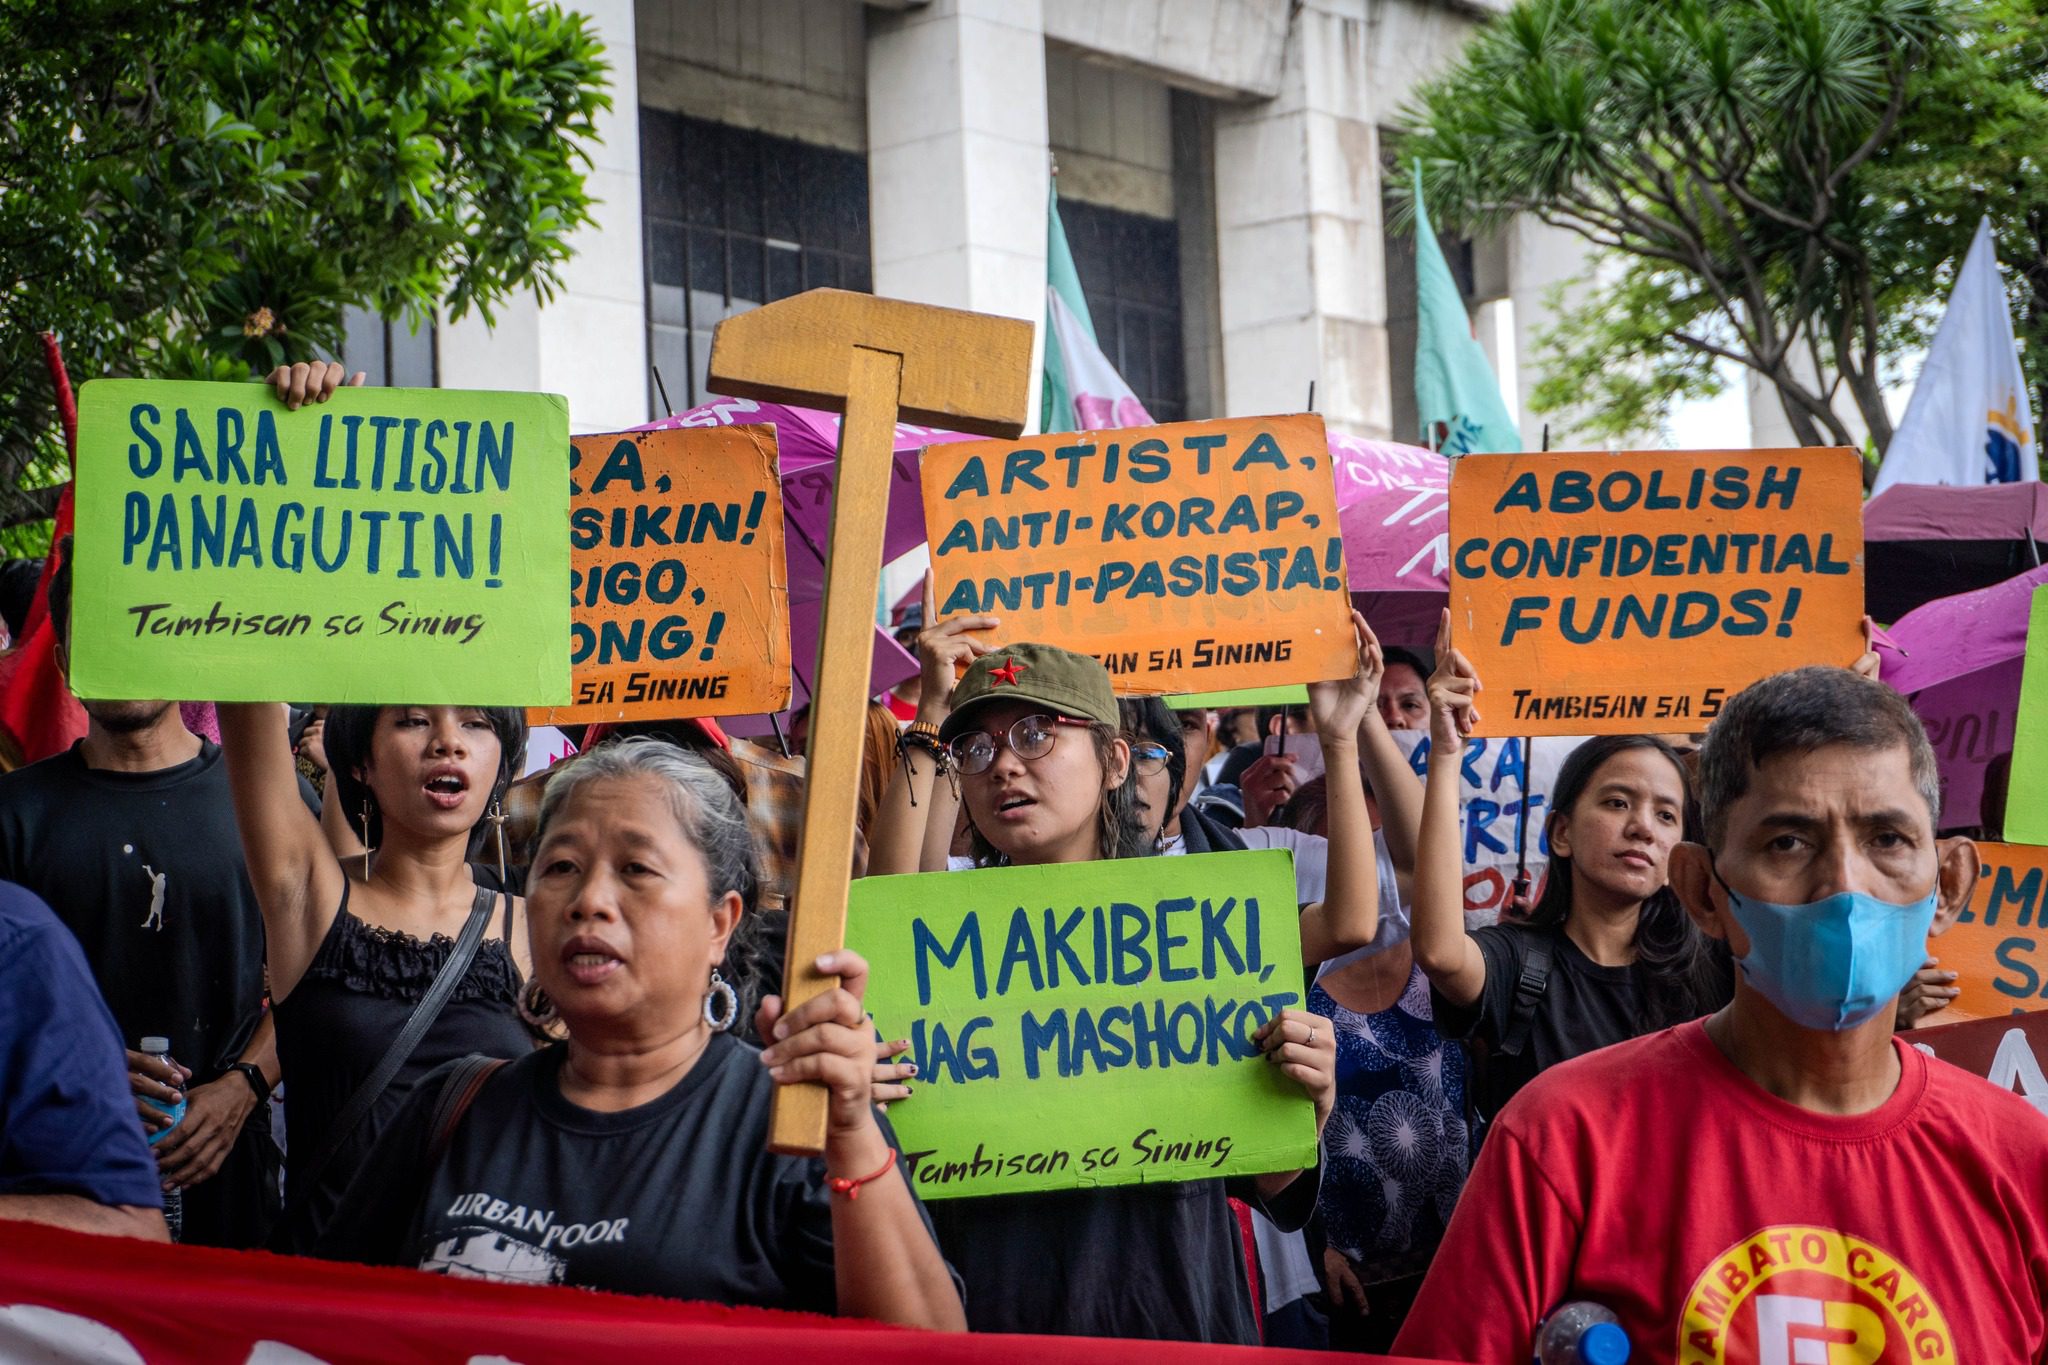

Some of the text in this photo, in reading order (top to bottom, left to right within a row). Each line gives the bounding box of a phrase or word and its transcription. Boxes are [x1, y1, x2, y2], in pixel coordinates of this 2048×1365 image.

[128, 403, 515, 494] SARA LITISIN
[944, 433, 1317, 499] ARTISTA,
[1493, 465, 1802, 514] ABOLISH
[123, 491, 503, 588] PANAGUTIN!
[937, 491, 1321, 556] ANTI-KORAP,
[940, 537, 1343, 616] ANTI-PASISTA!
[1454, 533, 1851, 580] CONFIDENTIAL
[127, 601, 486, 645] Tambisan sa Sining
[1500, 586, 1802, 647] FUNDS!
[1148, 648, 1183, 672] SA
[1192, 639, 1292, 668] SINING
[578, 672, 729, 705] SA SINING
[1512, 689, 1648, 720] TAMBISAN
[1654, 695, 1690, 719] SA
[911, 895, 1276, 1007] MAKIBEKI,
[904, 1128, 1235, 1185] Tambisan sa Sining
[447, 1193, 630, 1249] URBAN POOR
